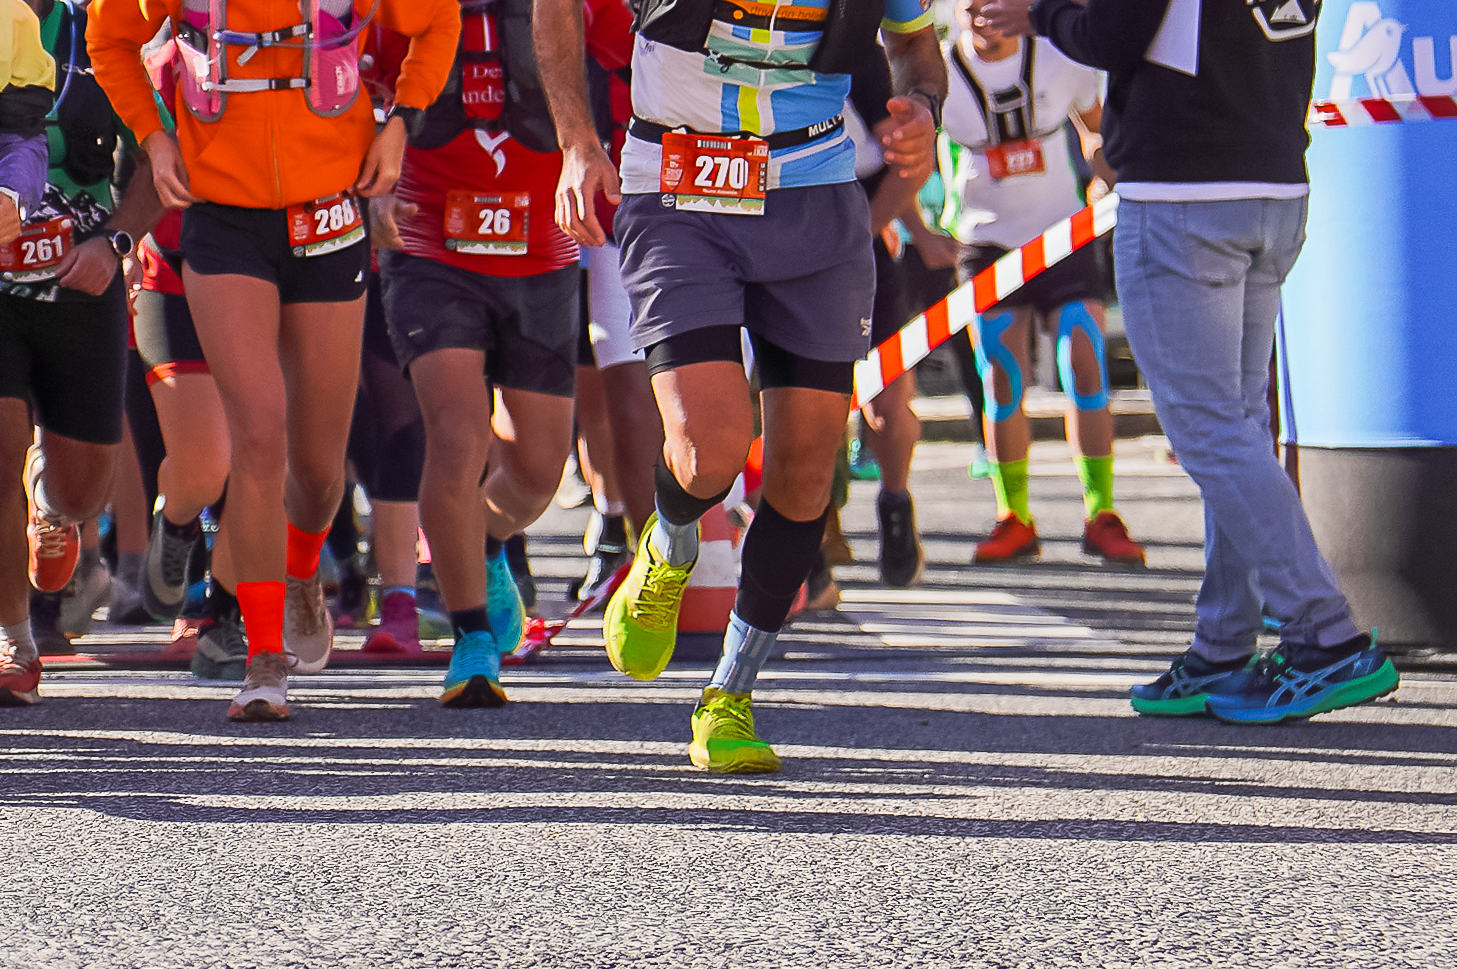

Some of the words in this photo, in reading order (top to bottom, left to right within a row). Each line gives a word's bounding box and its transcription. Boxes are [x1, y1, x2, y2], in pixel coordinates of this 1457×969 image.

[694, 154, 749, 189] 270
[478, 208, 511, 236] 26
[22, 234, 63, 265] 261
